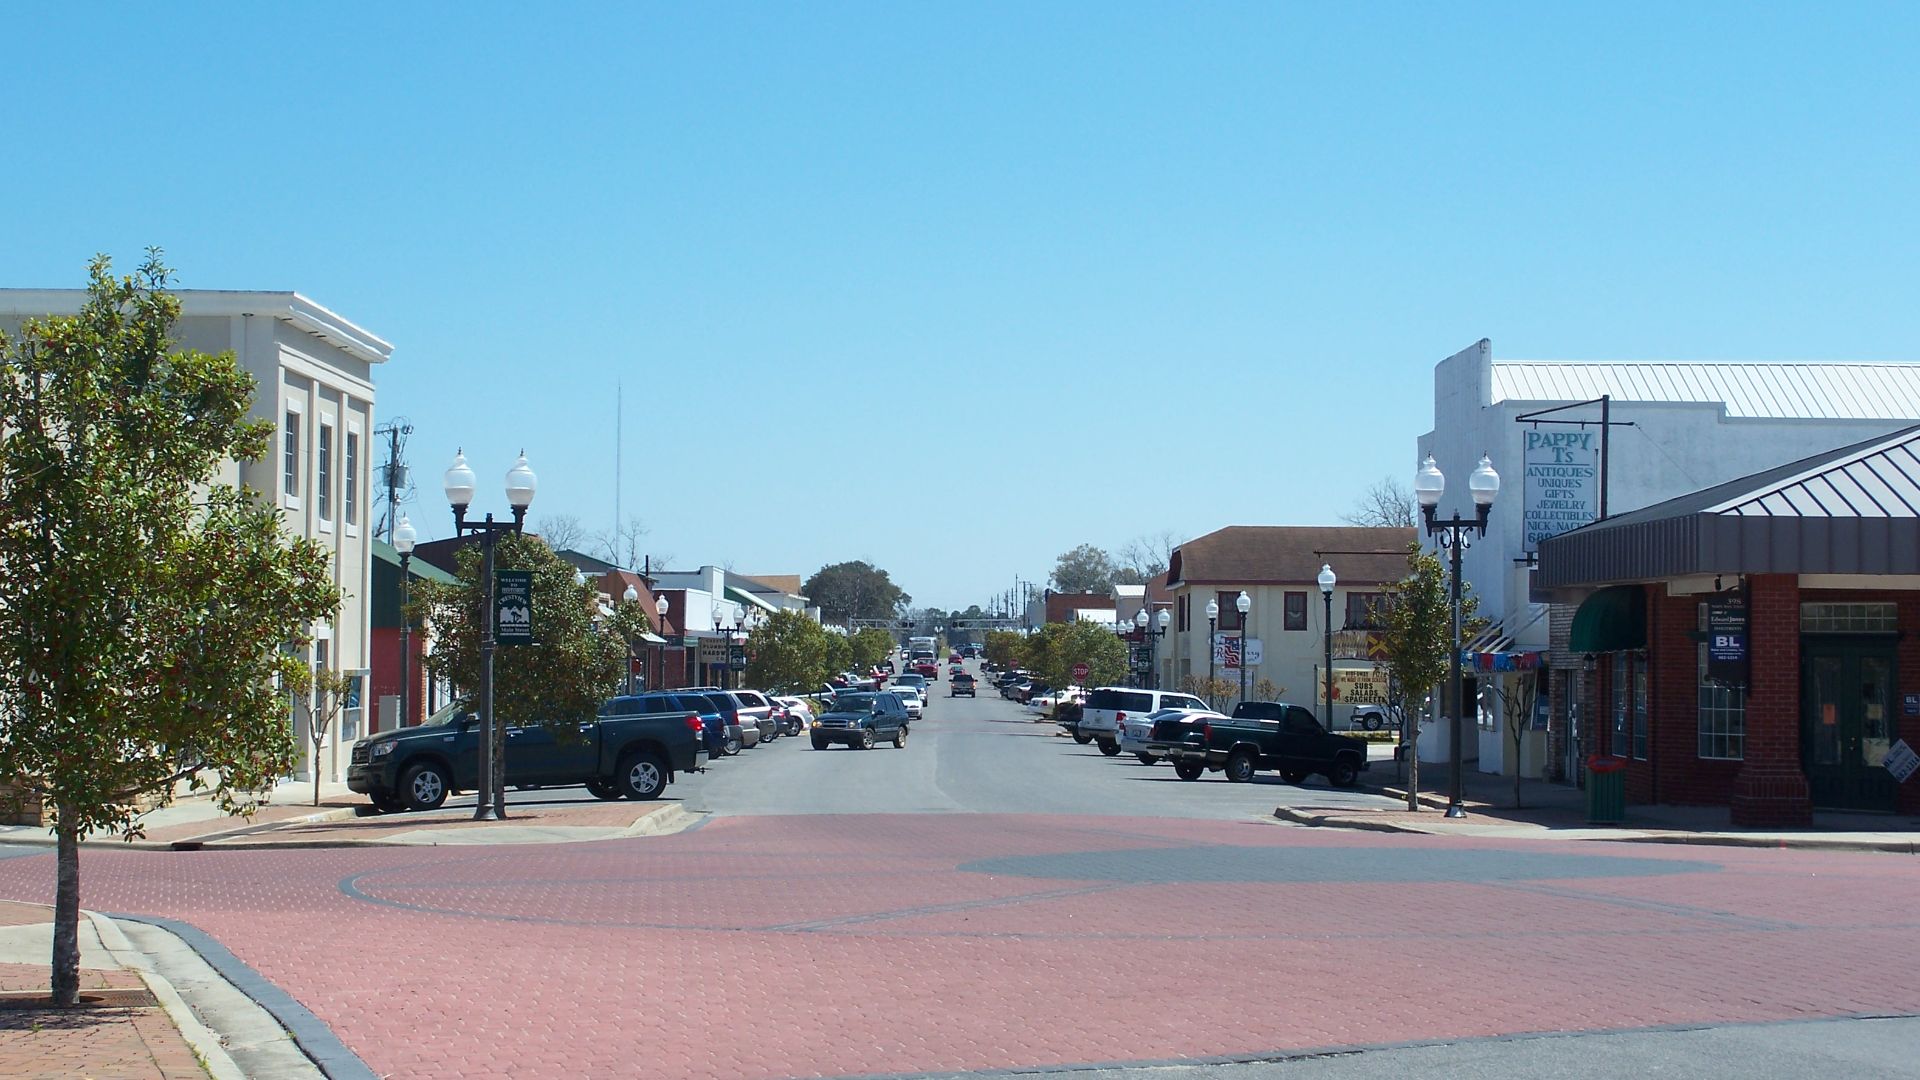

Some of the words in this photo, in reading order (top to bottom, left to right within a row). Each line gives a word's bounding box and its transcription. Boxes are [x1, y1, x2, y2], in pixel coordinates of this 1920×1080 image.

[1527, 432, 1592, 451] PAPPY
[1527, 467, 1594, 478] ANTIQUES
[1537, 478, 1582, 488] UNIQUES
[1545, 489, 1575, 498] GIFTS
[1536, 500, 1585, 510] JEWELRY
[1525, 510, 1594, 520] COLLECTIBLES
[498, 594, 527, 605] CRESTVIEW
[1716, 636, 1740, 647] BL
